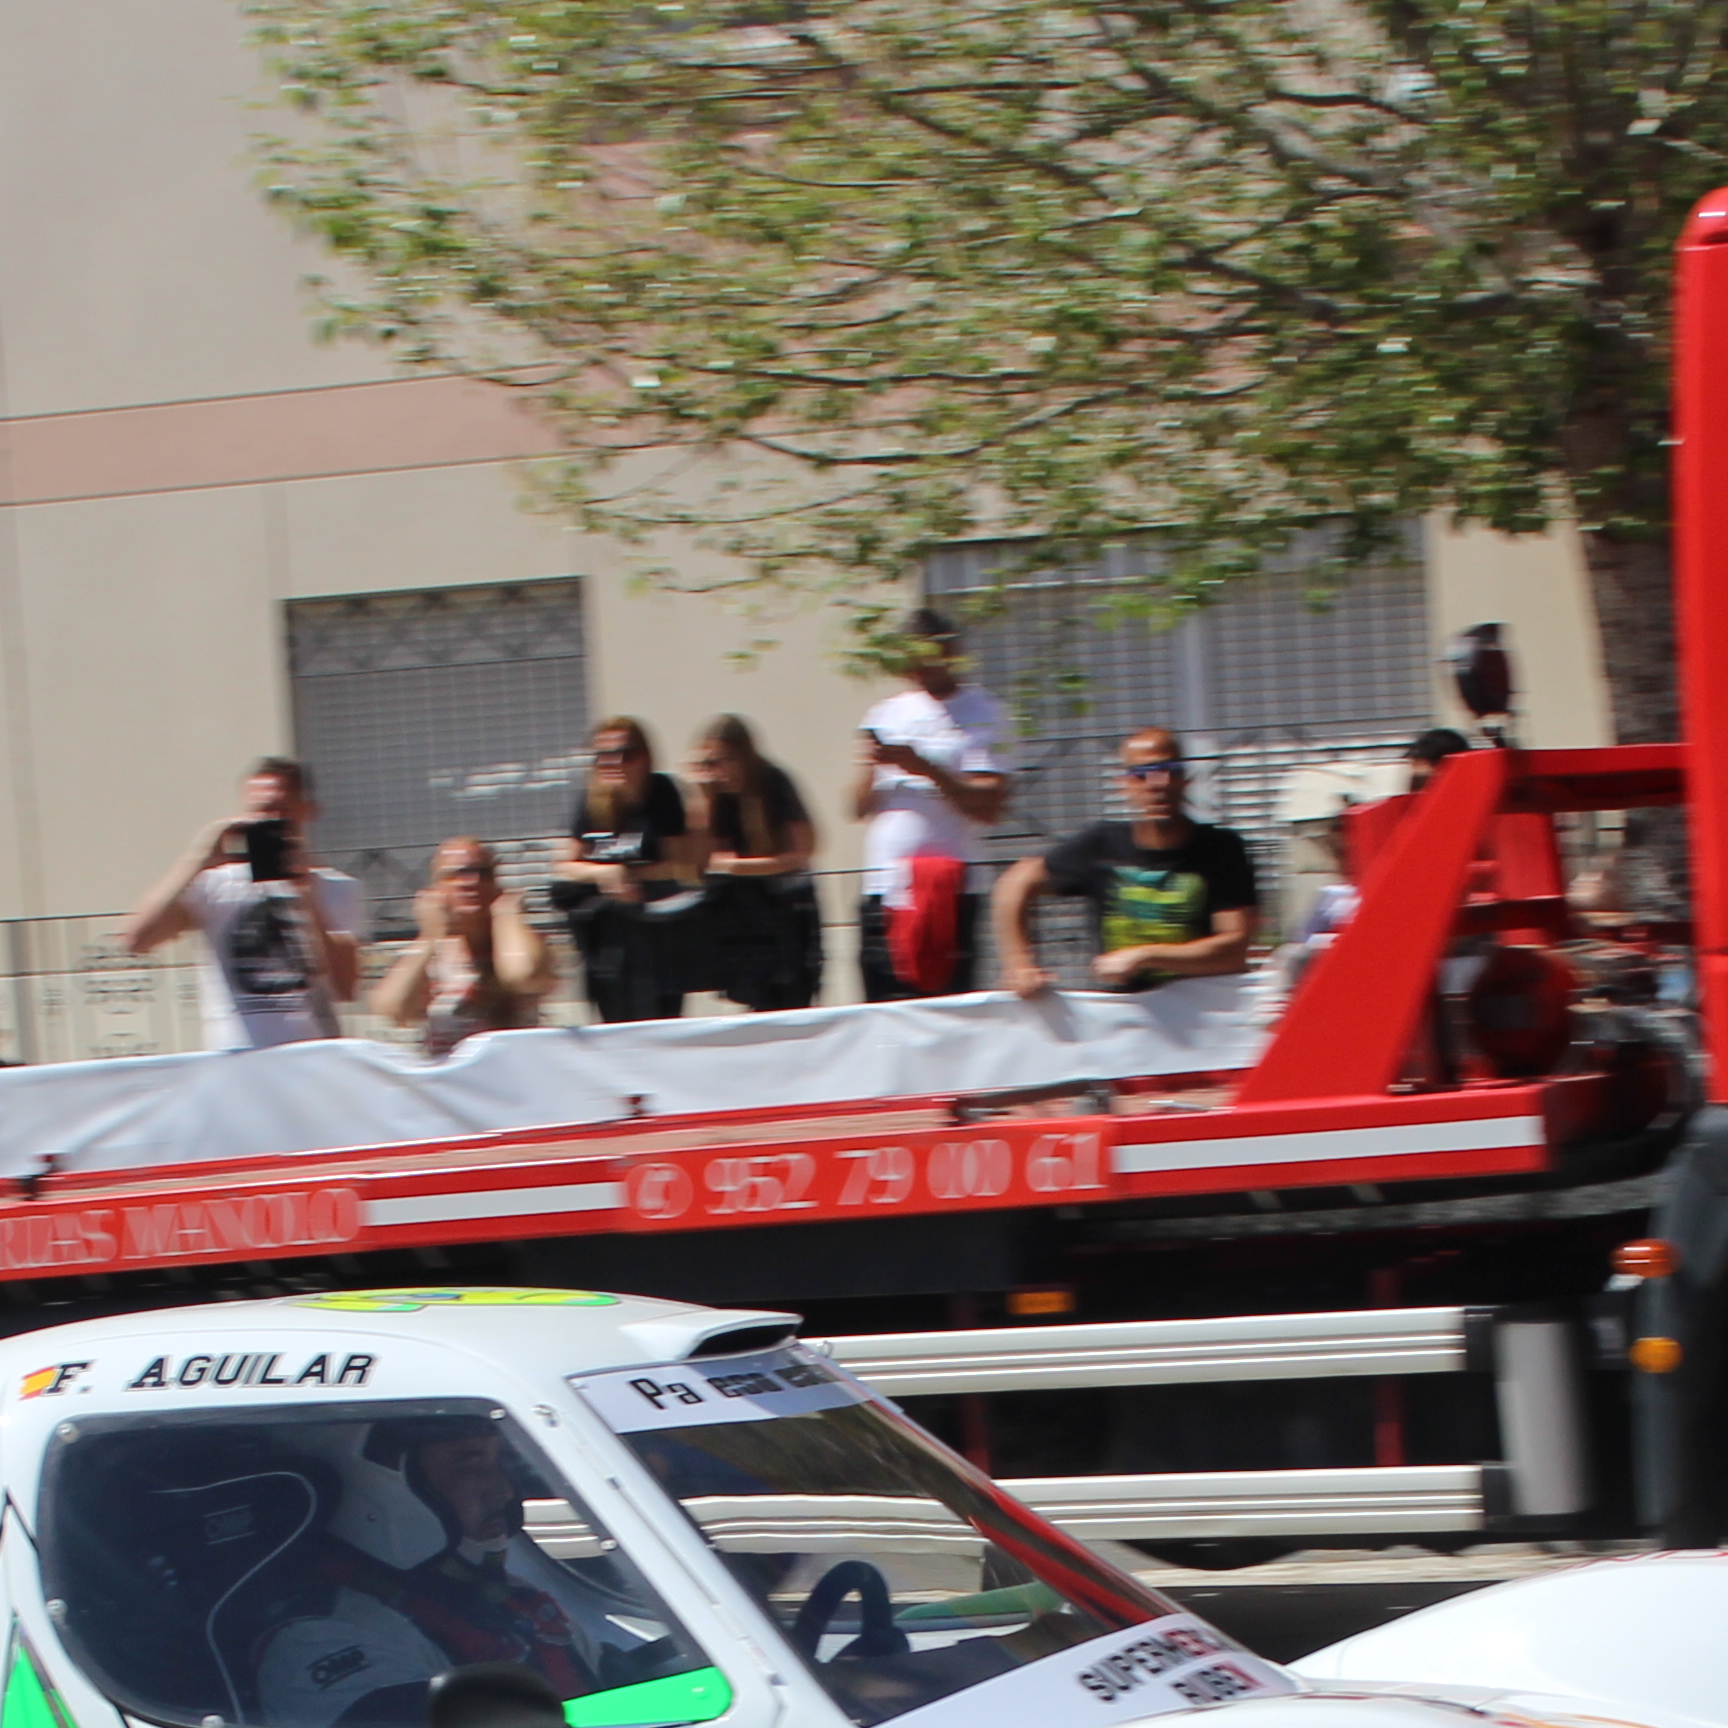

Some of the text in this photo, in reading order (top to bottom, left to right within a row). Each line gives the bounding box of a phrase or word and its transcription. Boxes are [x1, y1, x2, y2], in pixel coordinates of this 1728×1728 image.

[703, 1131, 1108, 1215] 952 79 00 61
[119, 1187, 362, 1260] MANOLO
[42, 1351, 378, 1396] F. AGUILAR
[628, 1376, 706, 1411] Pa
